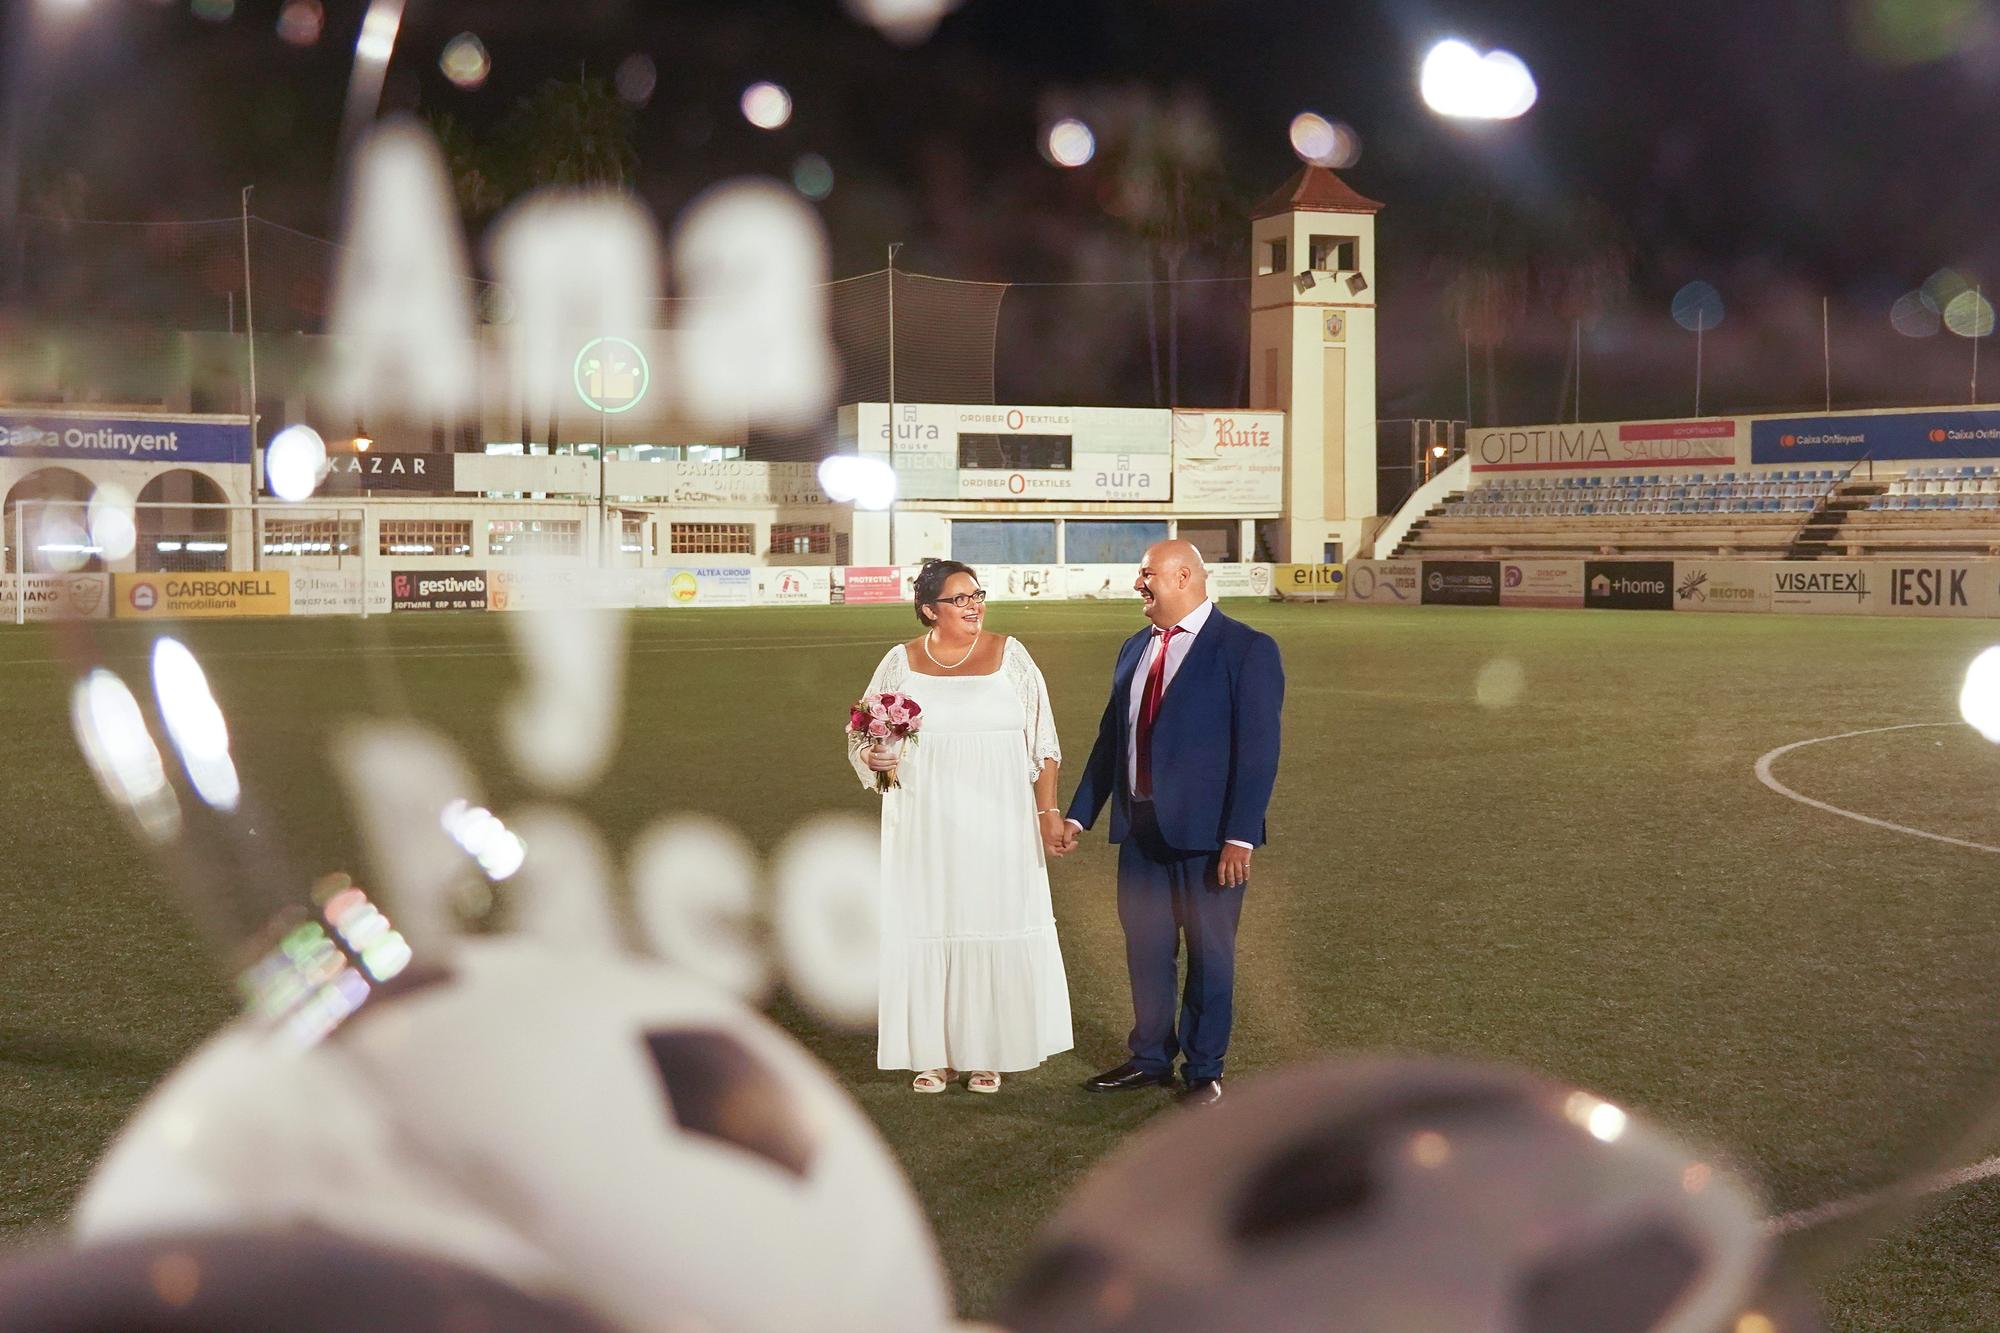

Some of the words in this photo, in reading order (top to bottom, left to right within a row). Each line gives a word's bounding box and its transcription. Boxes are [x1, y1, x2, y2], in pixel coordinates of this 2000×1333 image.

[960, 414, 1004, 422] ORDIBER
[1025, 415, 1070, 424] TEXTILES
[880, 423, 939, 440] aura
[1947, 429, 1974, 440] Caixa
[65, 428, 178, 455] Ontinyent
[1796, 435, 1821, 445] Caixa
[962, 479, 1006, 487] ORDIBER
[1027, 479, 1072, 488] TEXTILES
[1095, 471, 1150, 488] aura
[696, 568, 721, 577] ALTEA
[722, 568, 751, 577] GROUP
[848, 575, 892, 584] PROTECTEL
[165, 580, 276, 597] CARBONELL
[418, 576, 485, 596] gestiweb
[1612, 577, 1665, 594] +home
[1775, 573, 1858, 591] VISATEX
[394, 601, 431, 609] SOFTWARE
[435, 600, 449, 609] ERP
